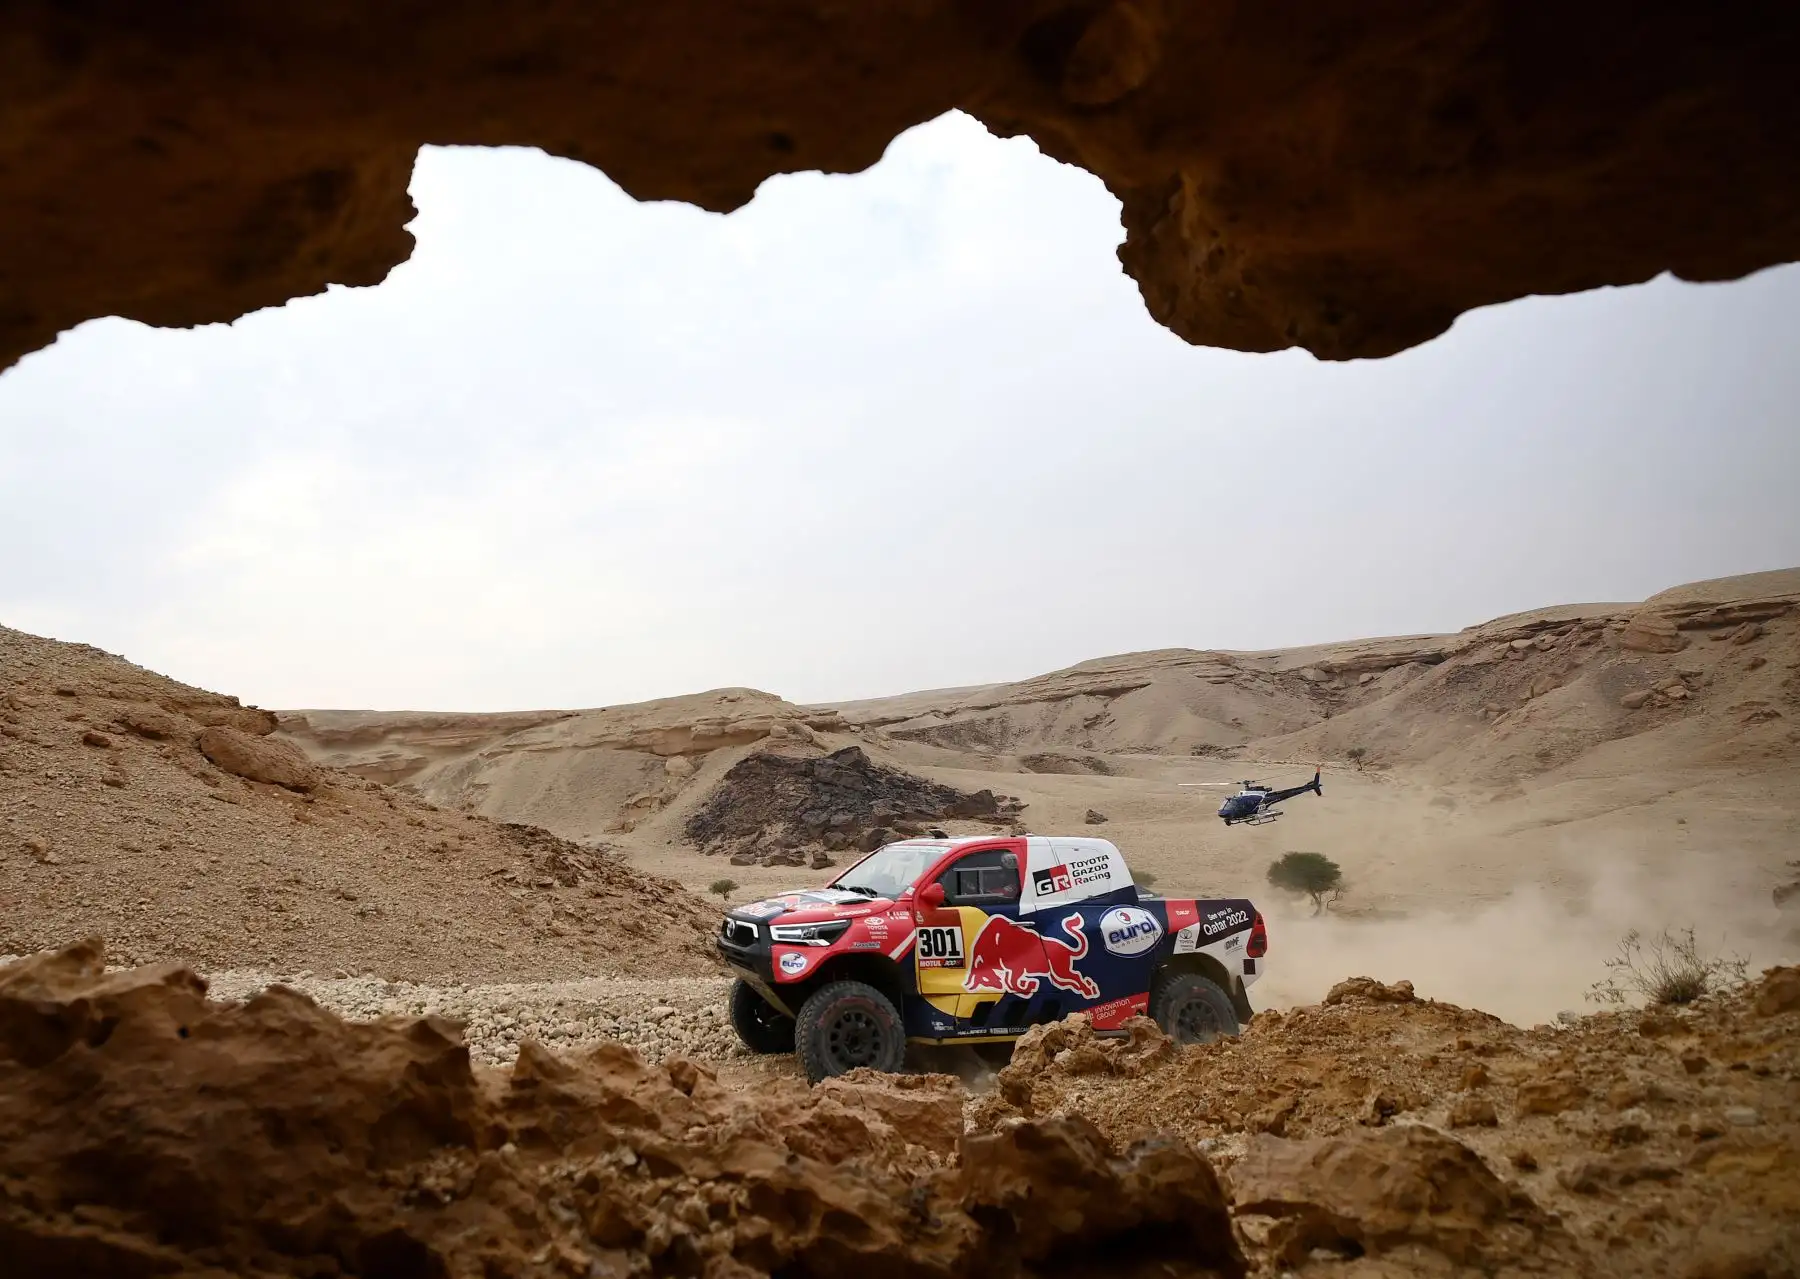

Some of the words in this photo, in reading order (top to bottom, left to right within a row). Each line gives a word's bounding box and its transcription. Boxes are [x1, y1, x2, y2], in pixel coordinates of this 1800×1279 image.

[1069, 854, 1110, 870] TOYOTA
[1072, 863, 1109, 878] GAZOO
[1035, 874, 1071, 896] GR
[1074, 871, 1111, 886] Racing
[1207, 912, 1218, 921] See
[1216, 908, 1228, 919] you
[1109, 916, 1156, 944] eurol
[1203, 920, 1228, 936] Qatar
[1225, 910, 1249, 927] 2022
[918, 928, 960, 957] 301
[782, 959, 804, 968] eurol
[1096, 1009, 1117, 1021] GROUP
